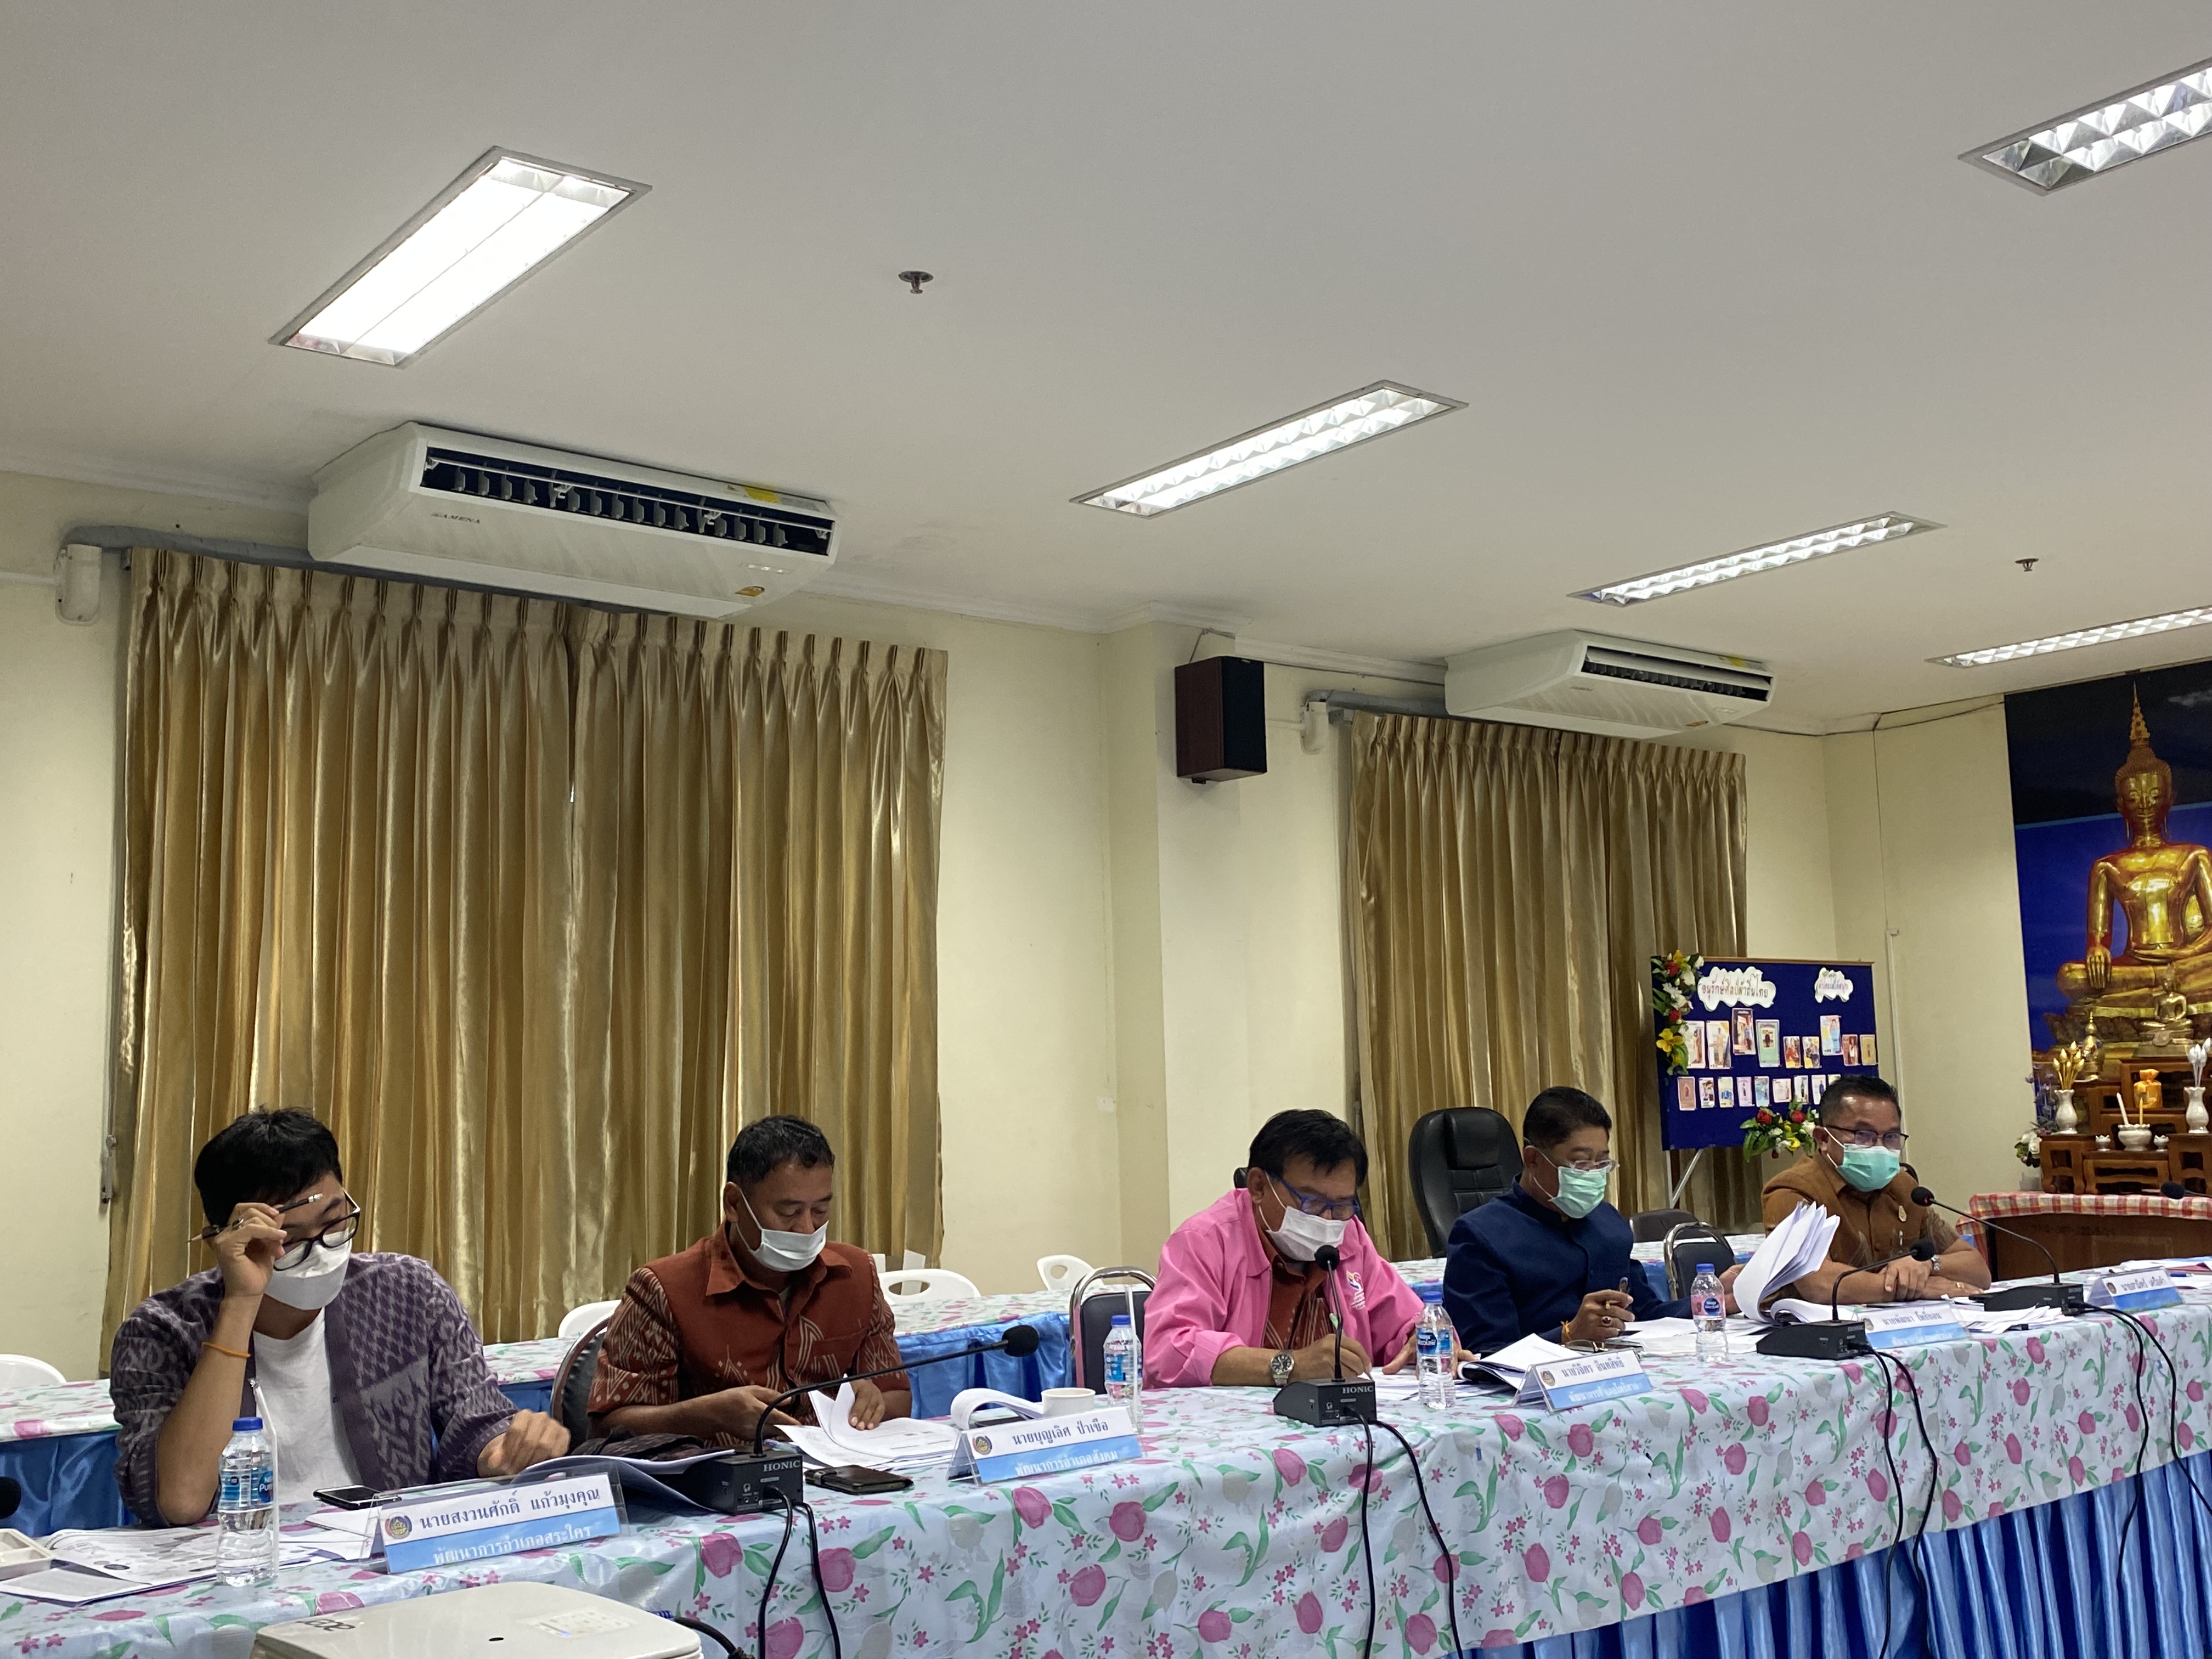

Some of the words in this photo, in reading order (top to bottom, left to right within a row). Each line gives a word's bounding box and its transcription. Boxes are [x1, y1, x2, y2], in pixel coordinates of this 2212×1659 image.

[1342, 1386, 1374, 1394] HONIC
[1012, 1425, 1071, 1445] นายบุญเลิศ
[763, 1460, 801, 1472] HONIC
[1014, 1450, 1119, 1476] พัฒนาการอำเภอสังคม
[420, 1490, 520, 1530] นายสงวนศักดิ์
[530, 1488, 600, 1510] แก้วมุงคุณ
[433, 1523, 592, 1565] พัฒนาการอำเภอสระใคร
